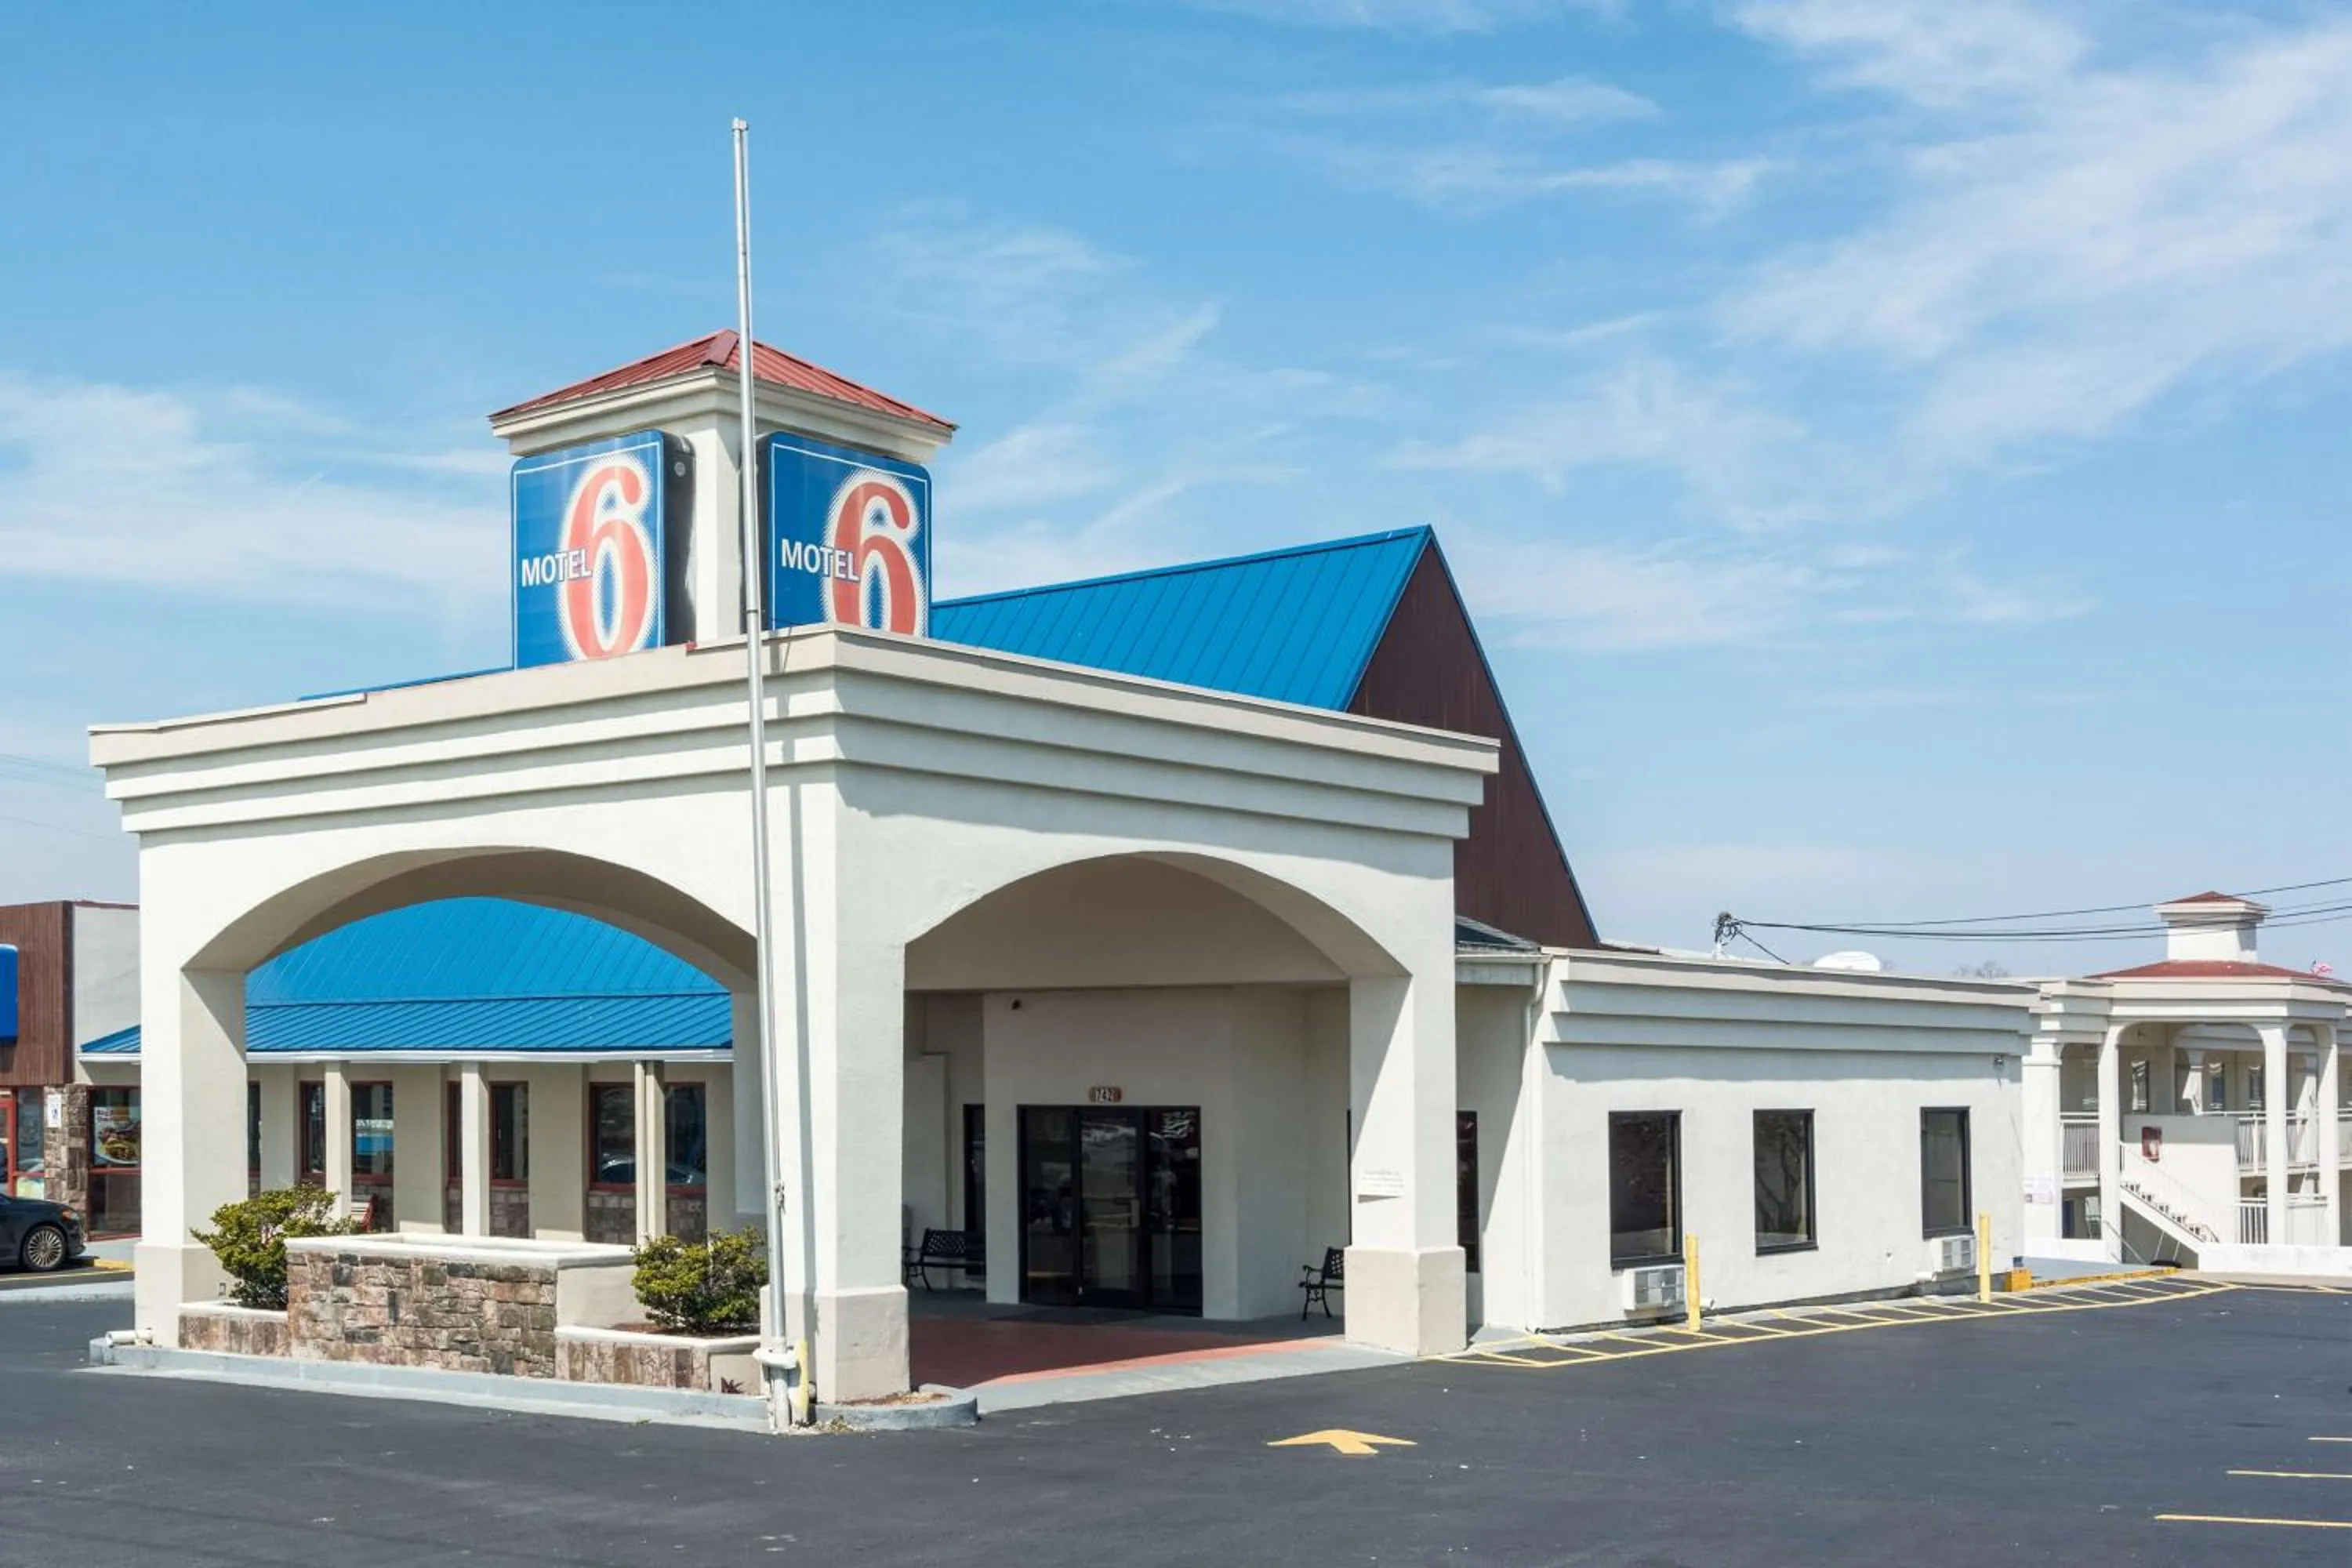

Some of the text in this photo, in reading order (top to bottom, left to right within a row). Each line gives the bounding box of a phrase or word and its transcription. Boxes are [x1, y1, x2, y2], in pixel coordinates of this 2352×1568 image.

[521, 465, 648, 661] MOTEL 6
[782, 481, 916, 637] MOTEL 6
